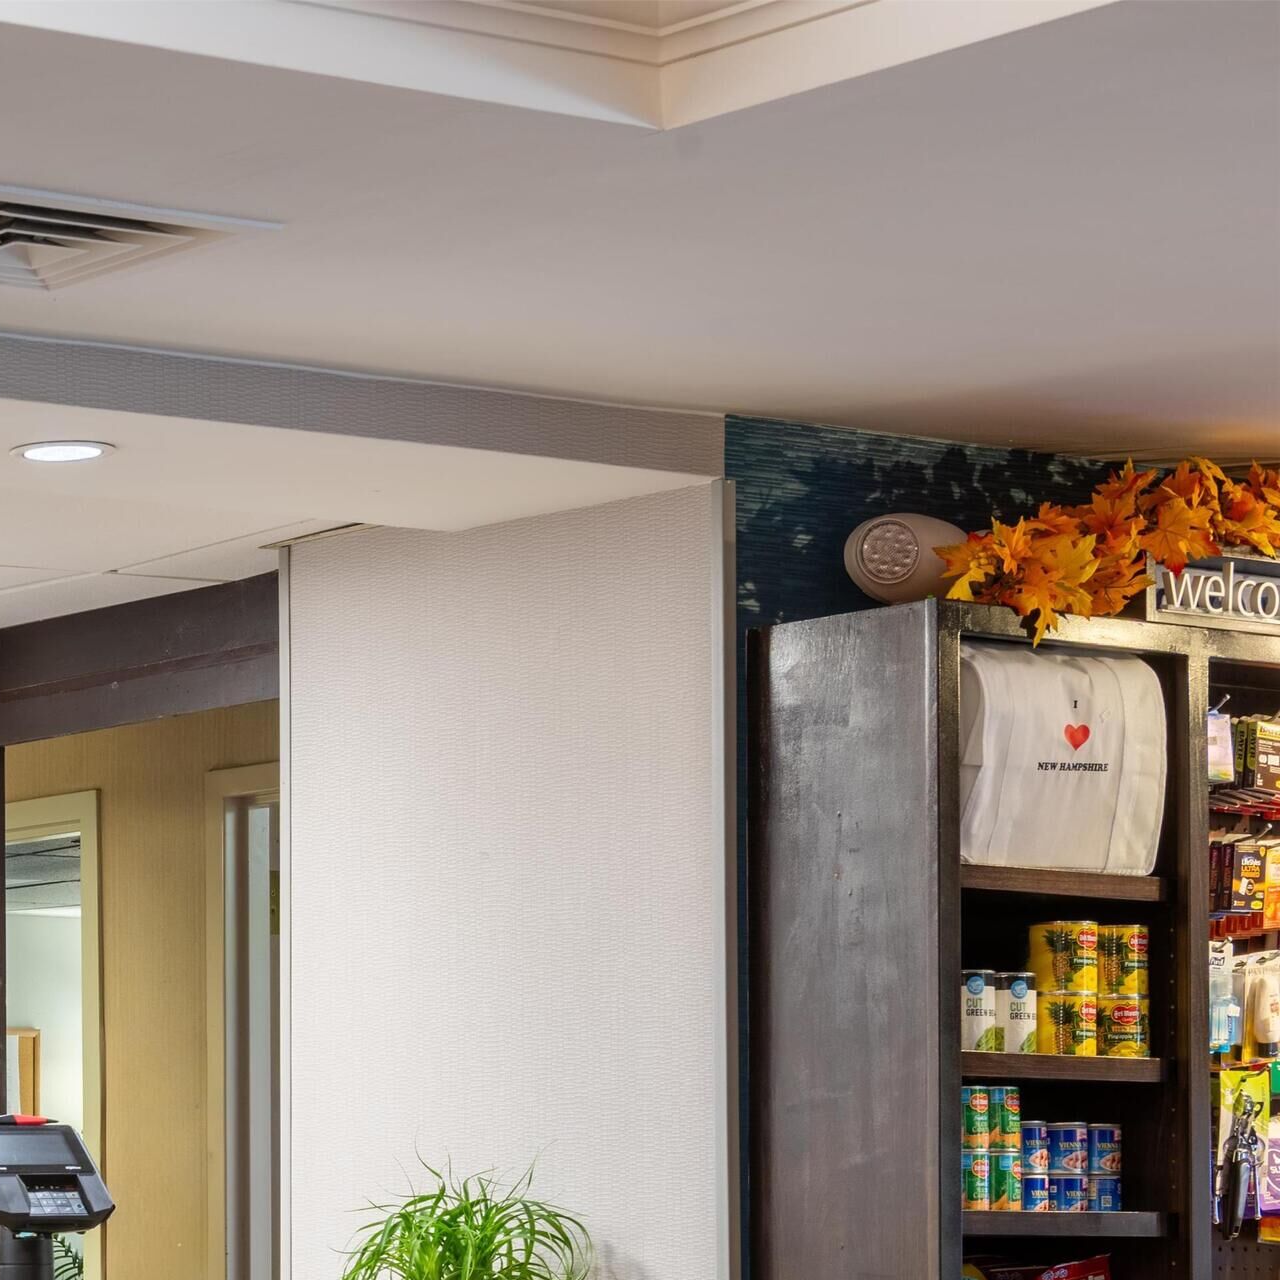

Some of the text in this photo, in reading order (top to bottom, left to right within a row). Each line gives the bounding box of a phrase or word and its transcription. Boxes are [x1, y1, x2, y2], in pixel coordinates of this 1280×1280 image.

[1073, 700, 1078, 708] I
[1037, 762, 1109, 772] NEW HAMPSHIRE
[966, 998, 983, 1008] CUT
[1010, 1002, 1026, 1012] CUT
[966, 1008, 988, 1017] GREEN
[1010, 1012, 1031, 1020] GREEN
